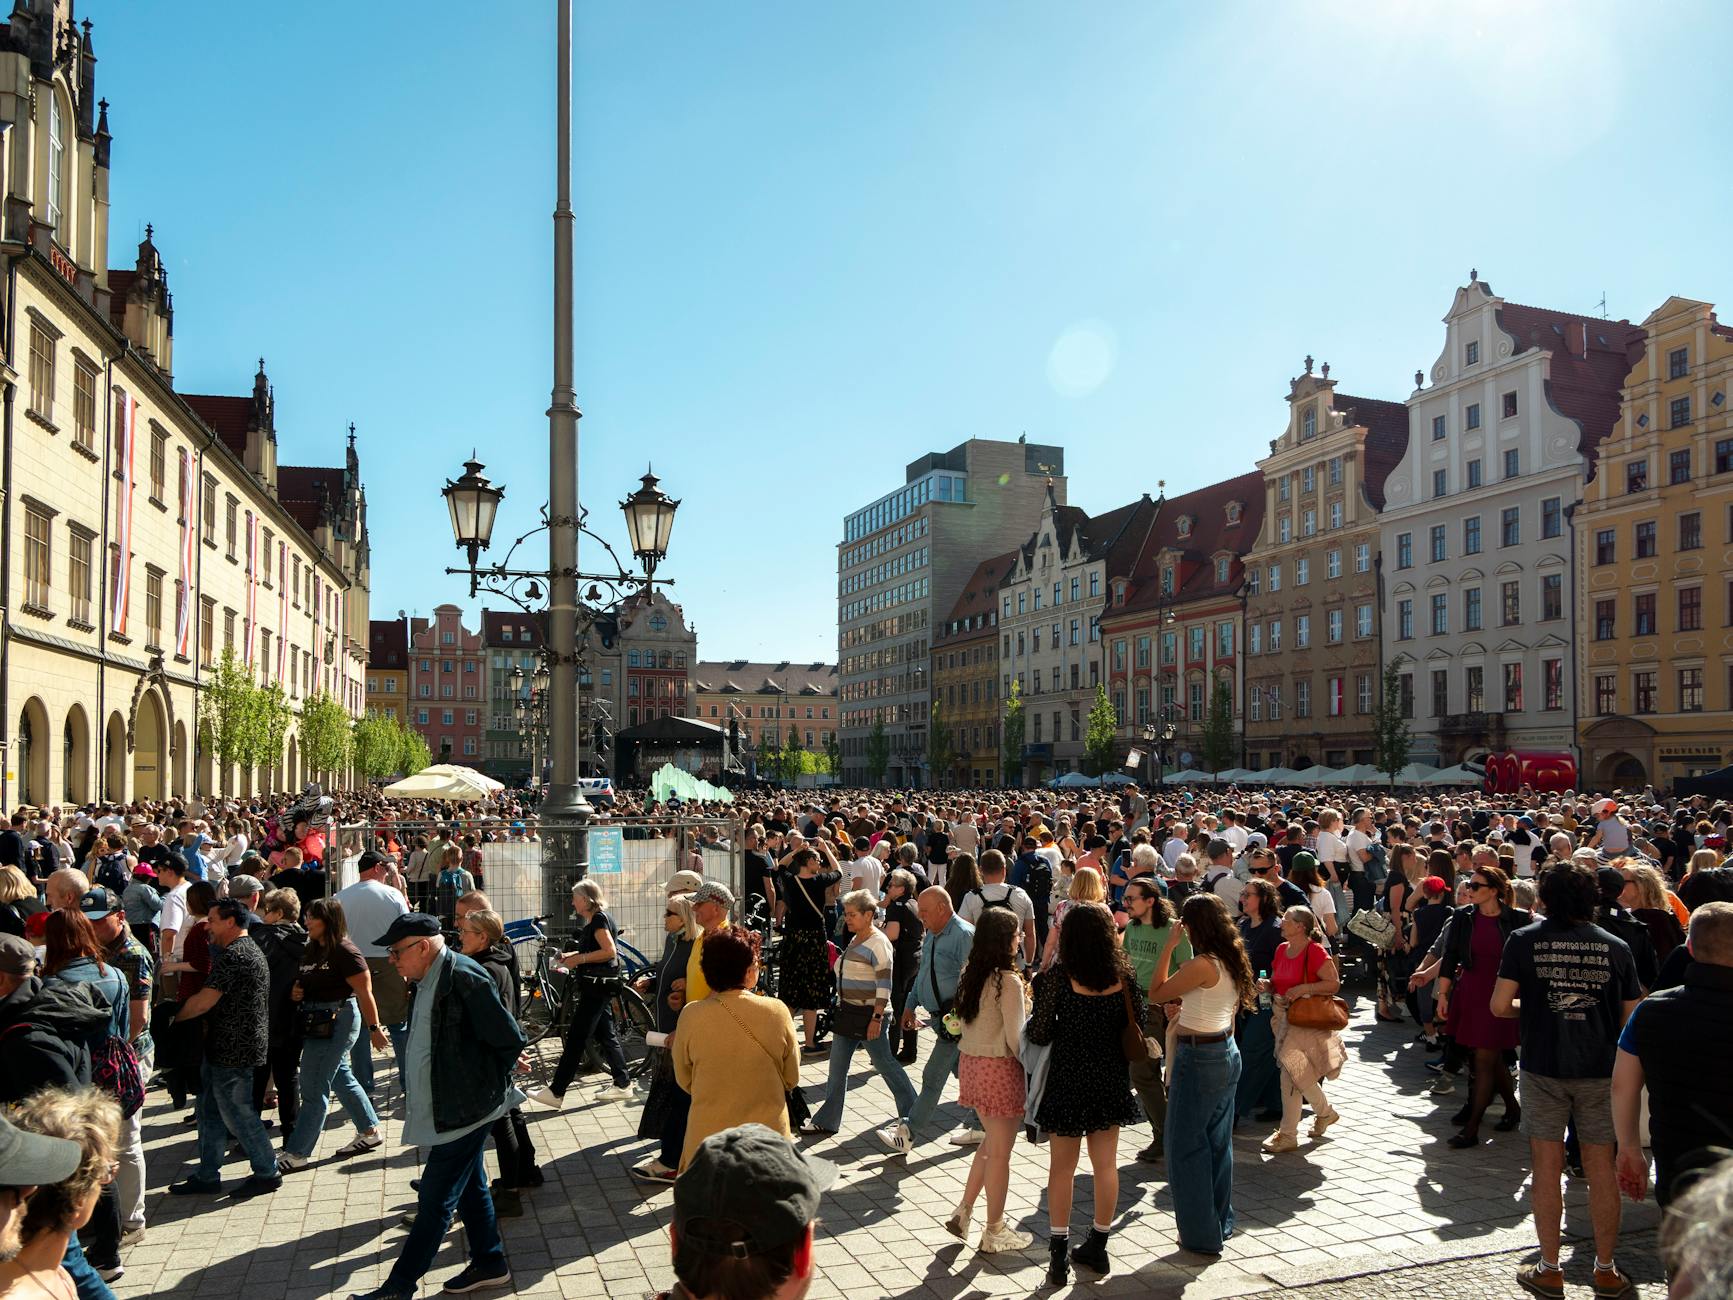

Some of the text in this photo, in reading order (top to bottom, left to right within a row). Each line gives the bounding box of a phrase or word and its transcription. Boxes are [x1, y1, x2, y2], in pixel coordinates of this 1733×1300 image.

[1139, 940, 1158, 954] STAR
[1534, 941, 1610, 952] NO SWIMMING
[1582, 955, 1610, 967] AREA
[1536, 966, 1611, 983] BEACH CLOSED
